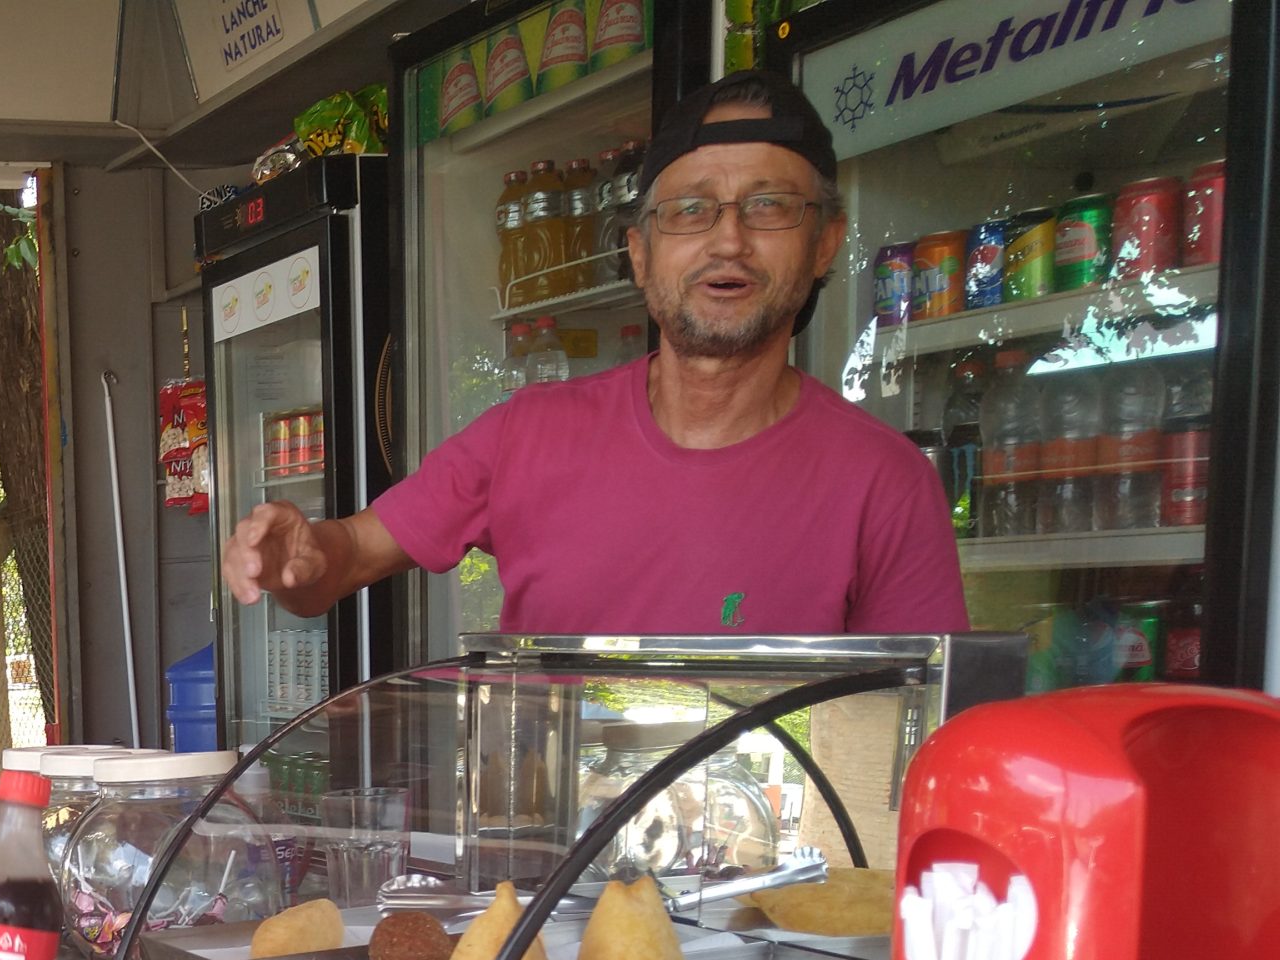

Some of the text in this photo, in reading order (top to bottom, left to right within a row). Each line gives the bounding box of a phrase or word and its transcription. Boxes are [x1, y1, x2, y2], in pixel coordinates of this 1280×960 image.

[223, 15, 281, 66] NATURAL
[884, 0, 1202, 106] Metalfr
[248, 197, 265, 224] 03
